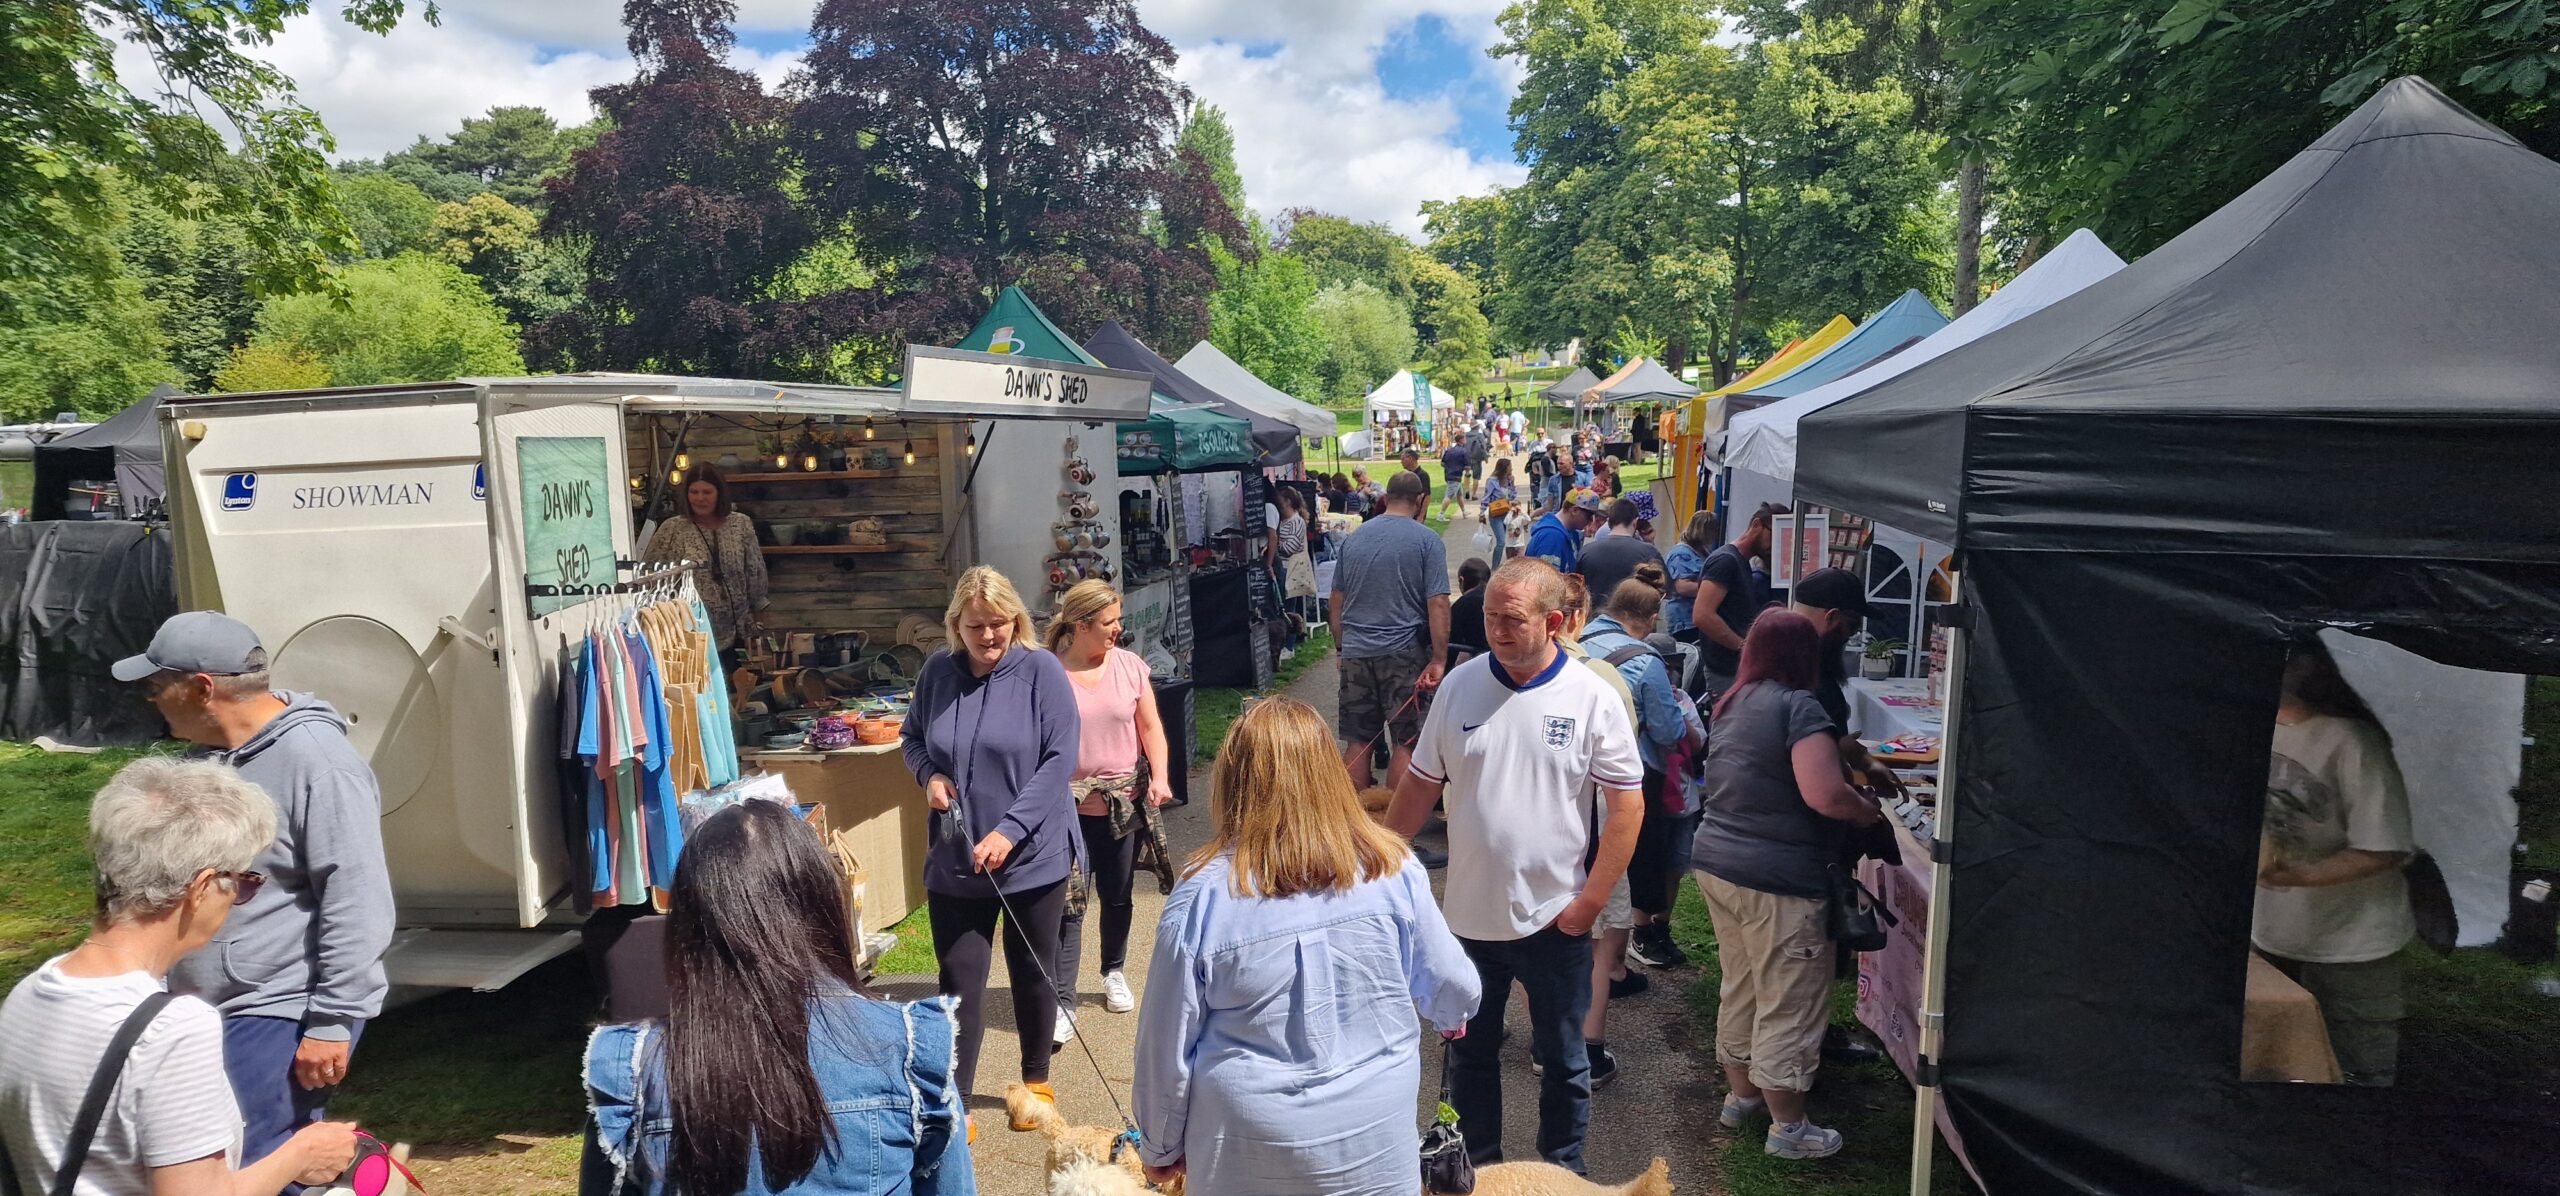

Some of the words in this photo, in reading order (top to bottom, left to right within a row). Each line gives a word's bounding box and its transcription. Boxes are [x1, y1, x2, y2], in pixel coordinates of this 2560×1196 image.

[1004, 366, 1053, 402] DAWN'S
[1058, 374, 1088, 405] SHED
[293, 482, 434, 510] SHOWMAN
[541, 479, 594, 522] DAWN'S
[556, 543, 591, 587] SHED
